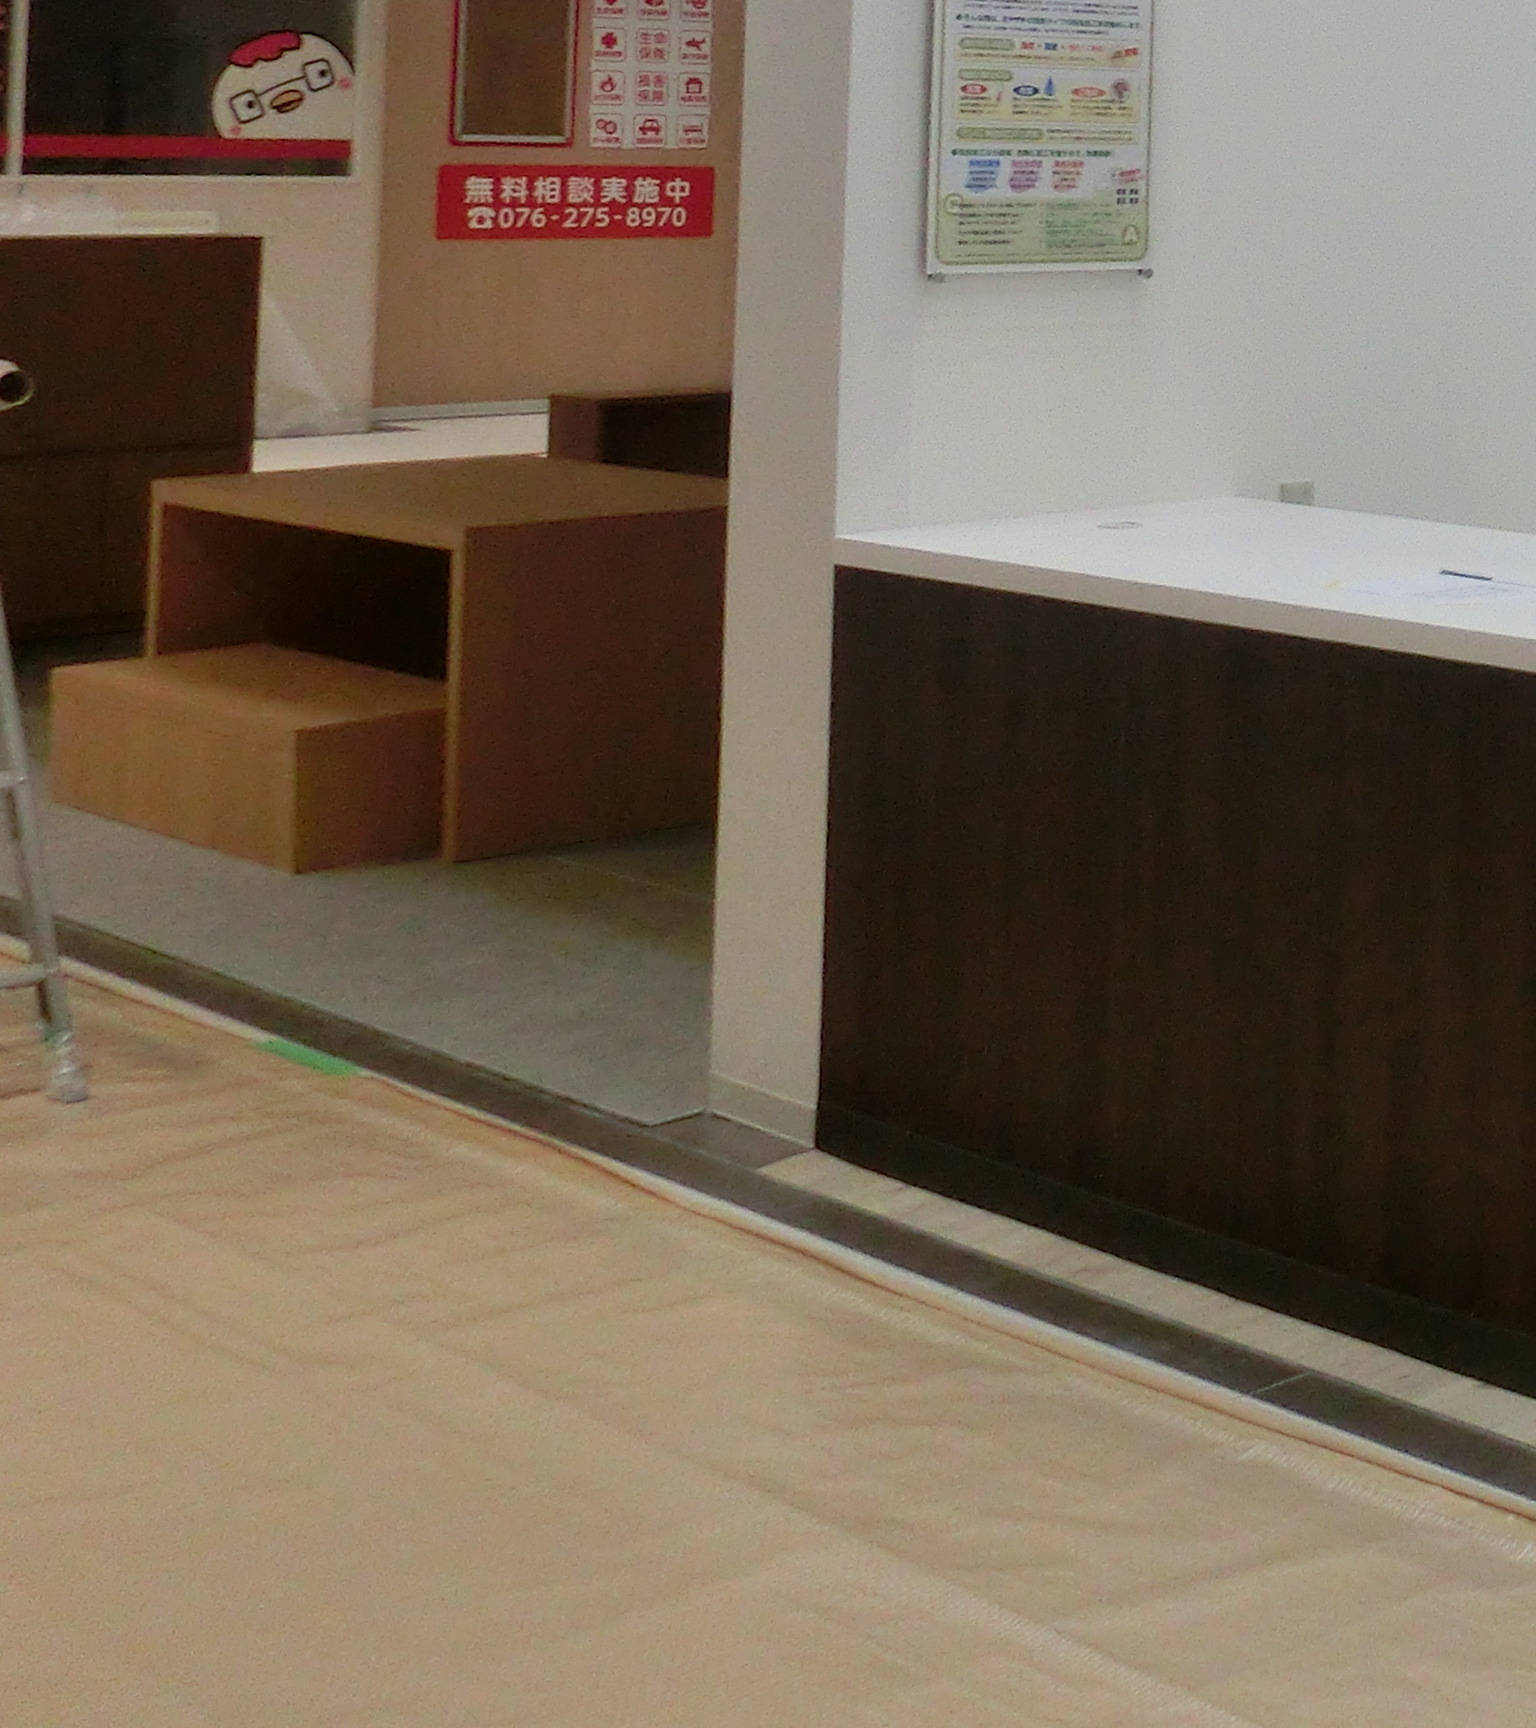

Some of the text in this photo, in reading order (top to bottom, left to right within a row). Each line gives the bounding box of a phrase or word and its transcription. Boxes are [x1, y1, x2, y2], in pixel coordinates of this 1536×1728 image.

[464, 175, 691, 204] 無料相談実施中
[498, 206, 687, 229] 076-275-8970
